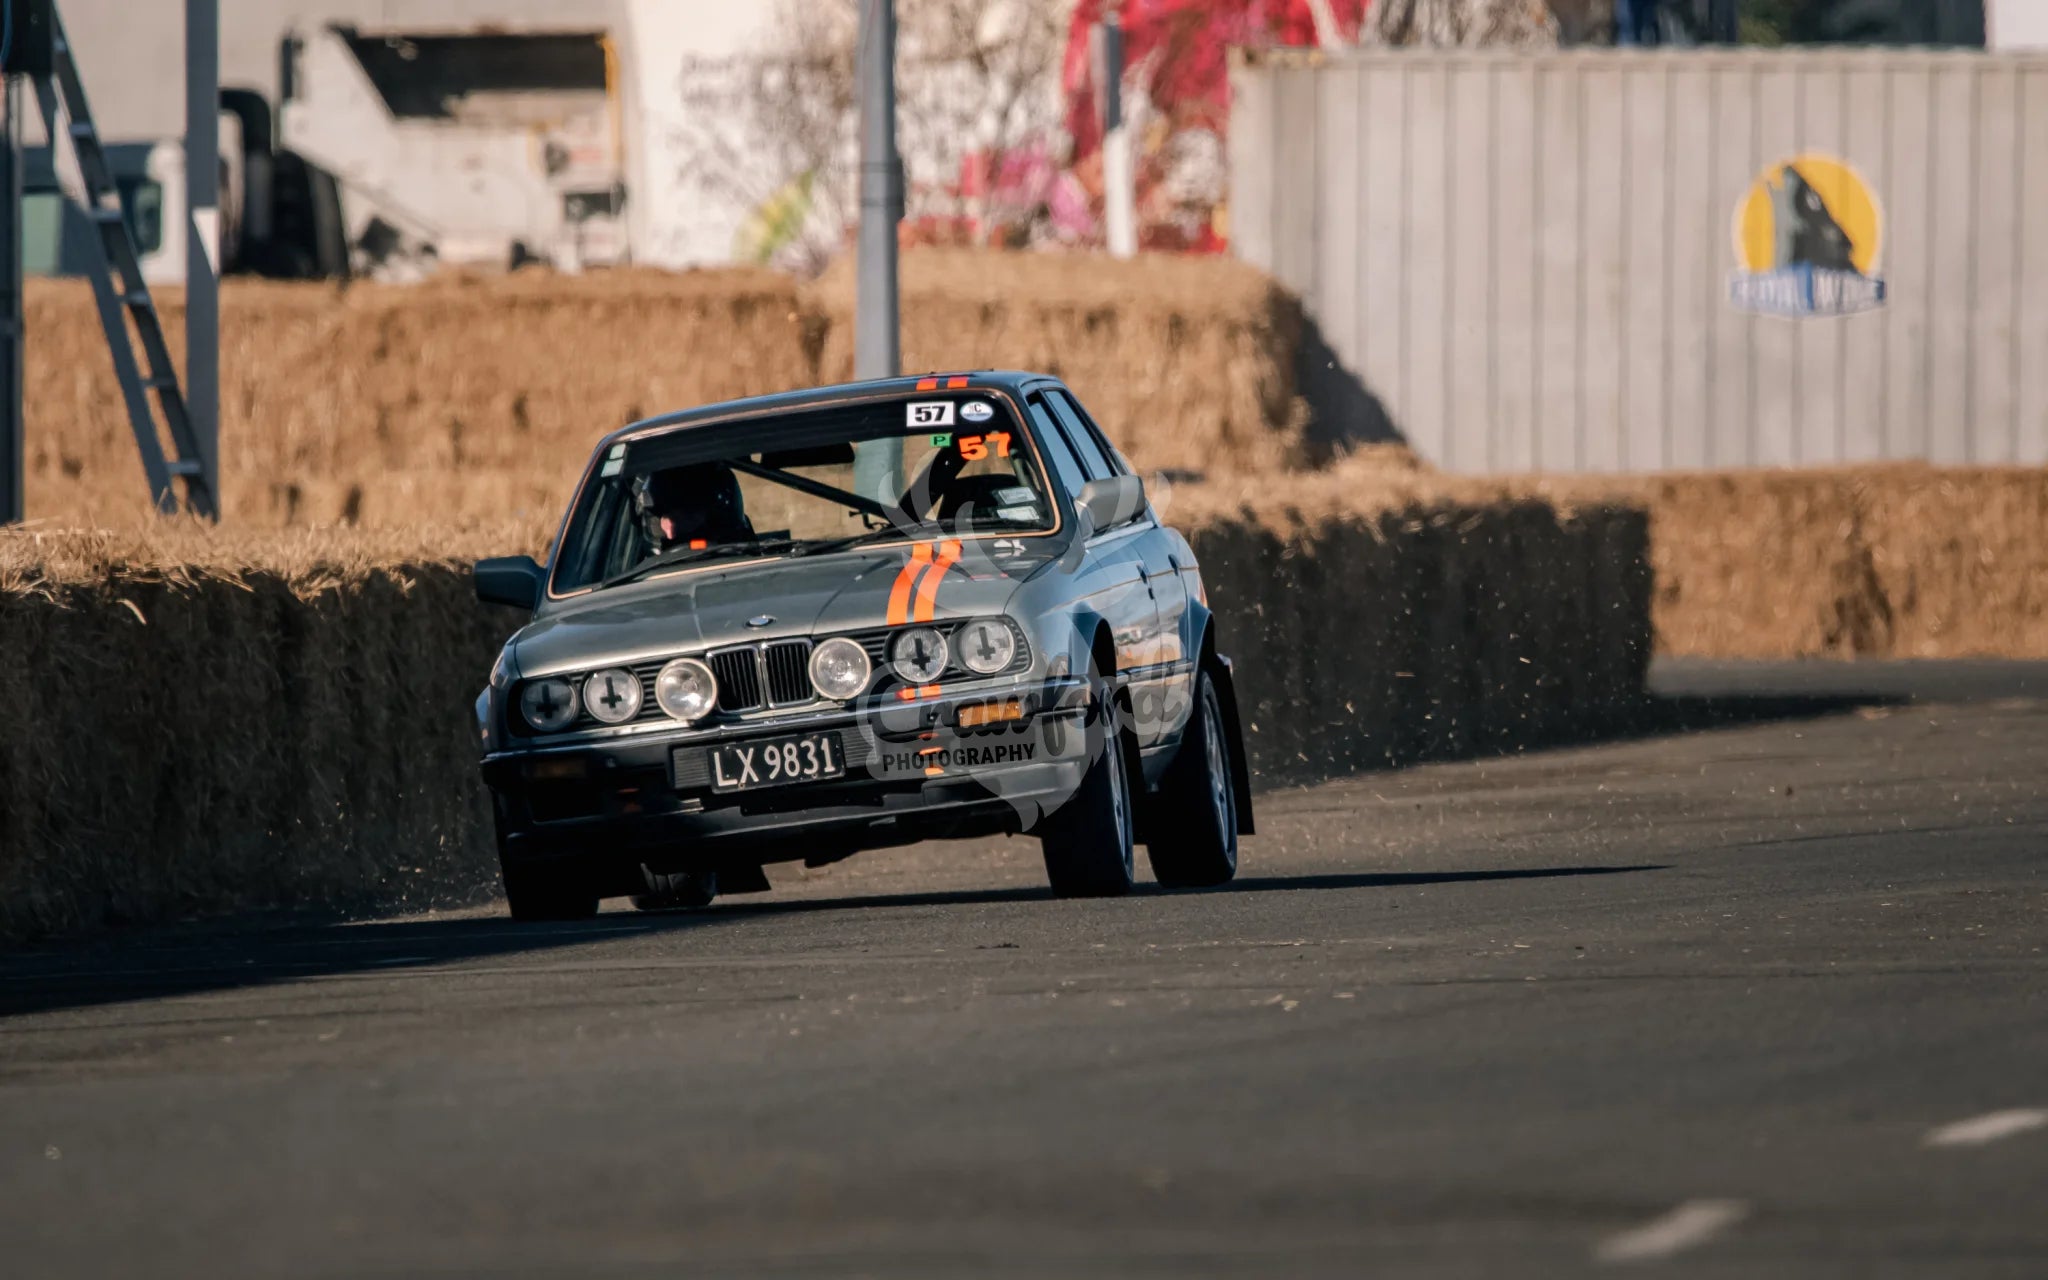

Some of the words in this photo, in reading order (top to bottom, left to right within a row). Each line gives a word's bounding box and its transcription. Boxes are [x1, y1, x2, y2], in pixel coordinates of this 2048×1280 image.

[914, 405, 946, 422] 57
[933, 436, 946, 446] P
[958, 432, 1011, 461] 57
[713, 747, 760, 787] LX
[764, 738, 836, 780] 9831
